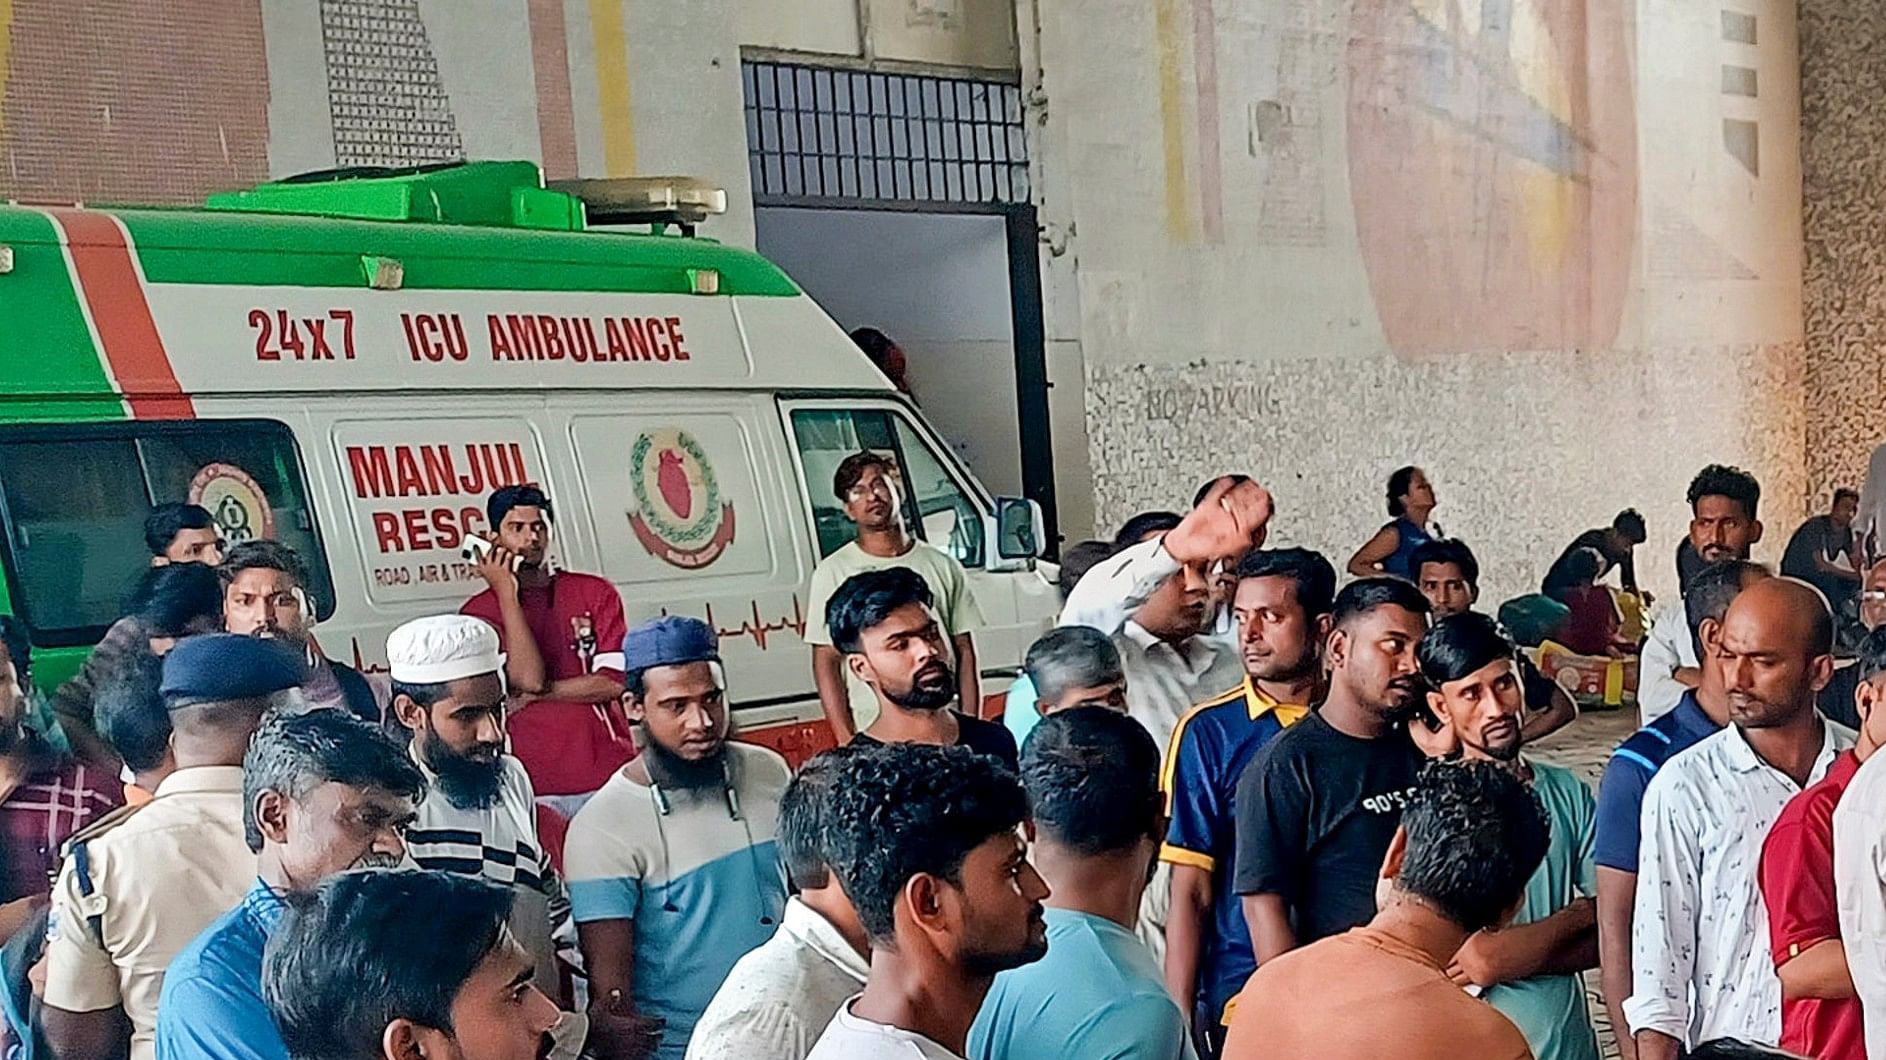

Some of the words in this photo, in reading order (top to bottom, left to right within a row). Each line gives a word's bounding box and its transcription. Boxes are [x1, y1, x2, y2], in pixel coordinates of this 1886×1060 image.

[400, 313, 469, 362] ICU
[487, 314, 690, 362] AMBULANCE
[372, 507, 486, 553] RESC
